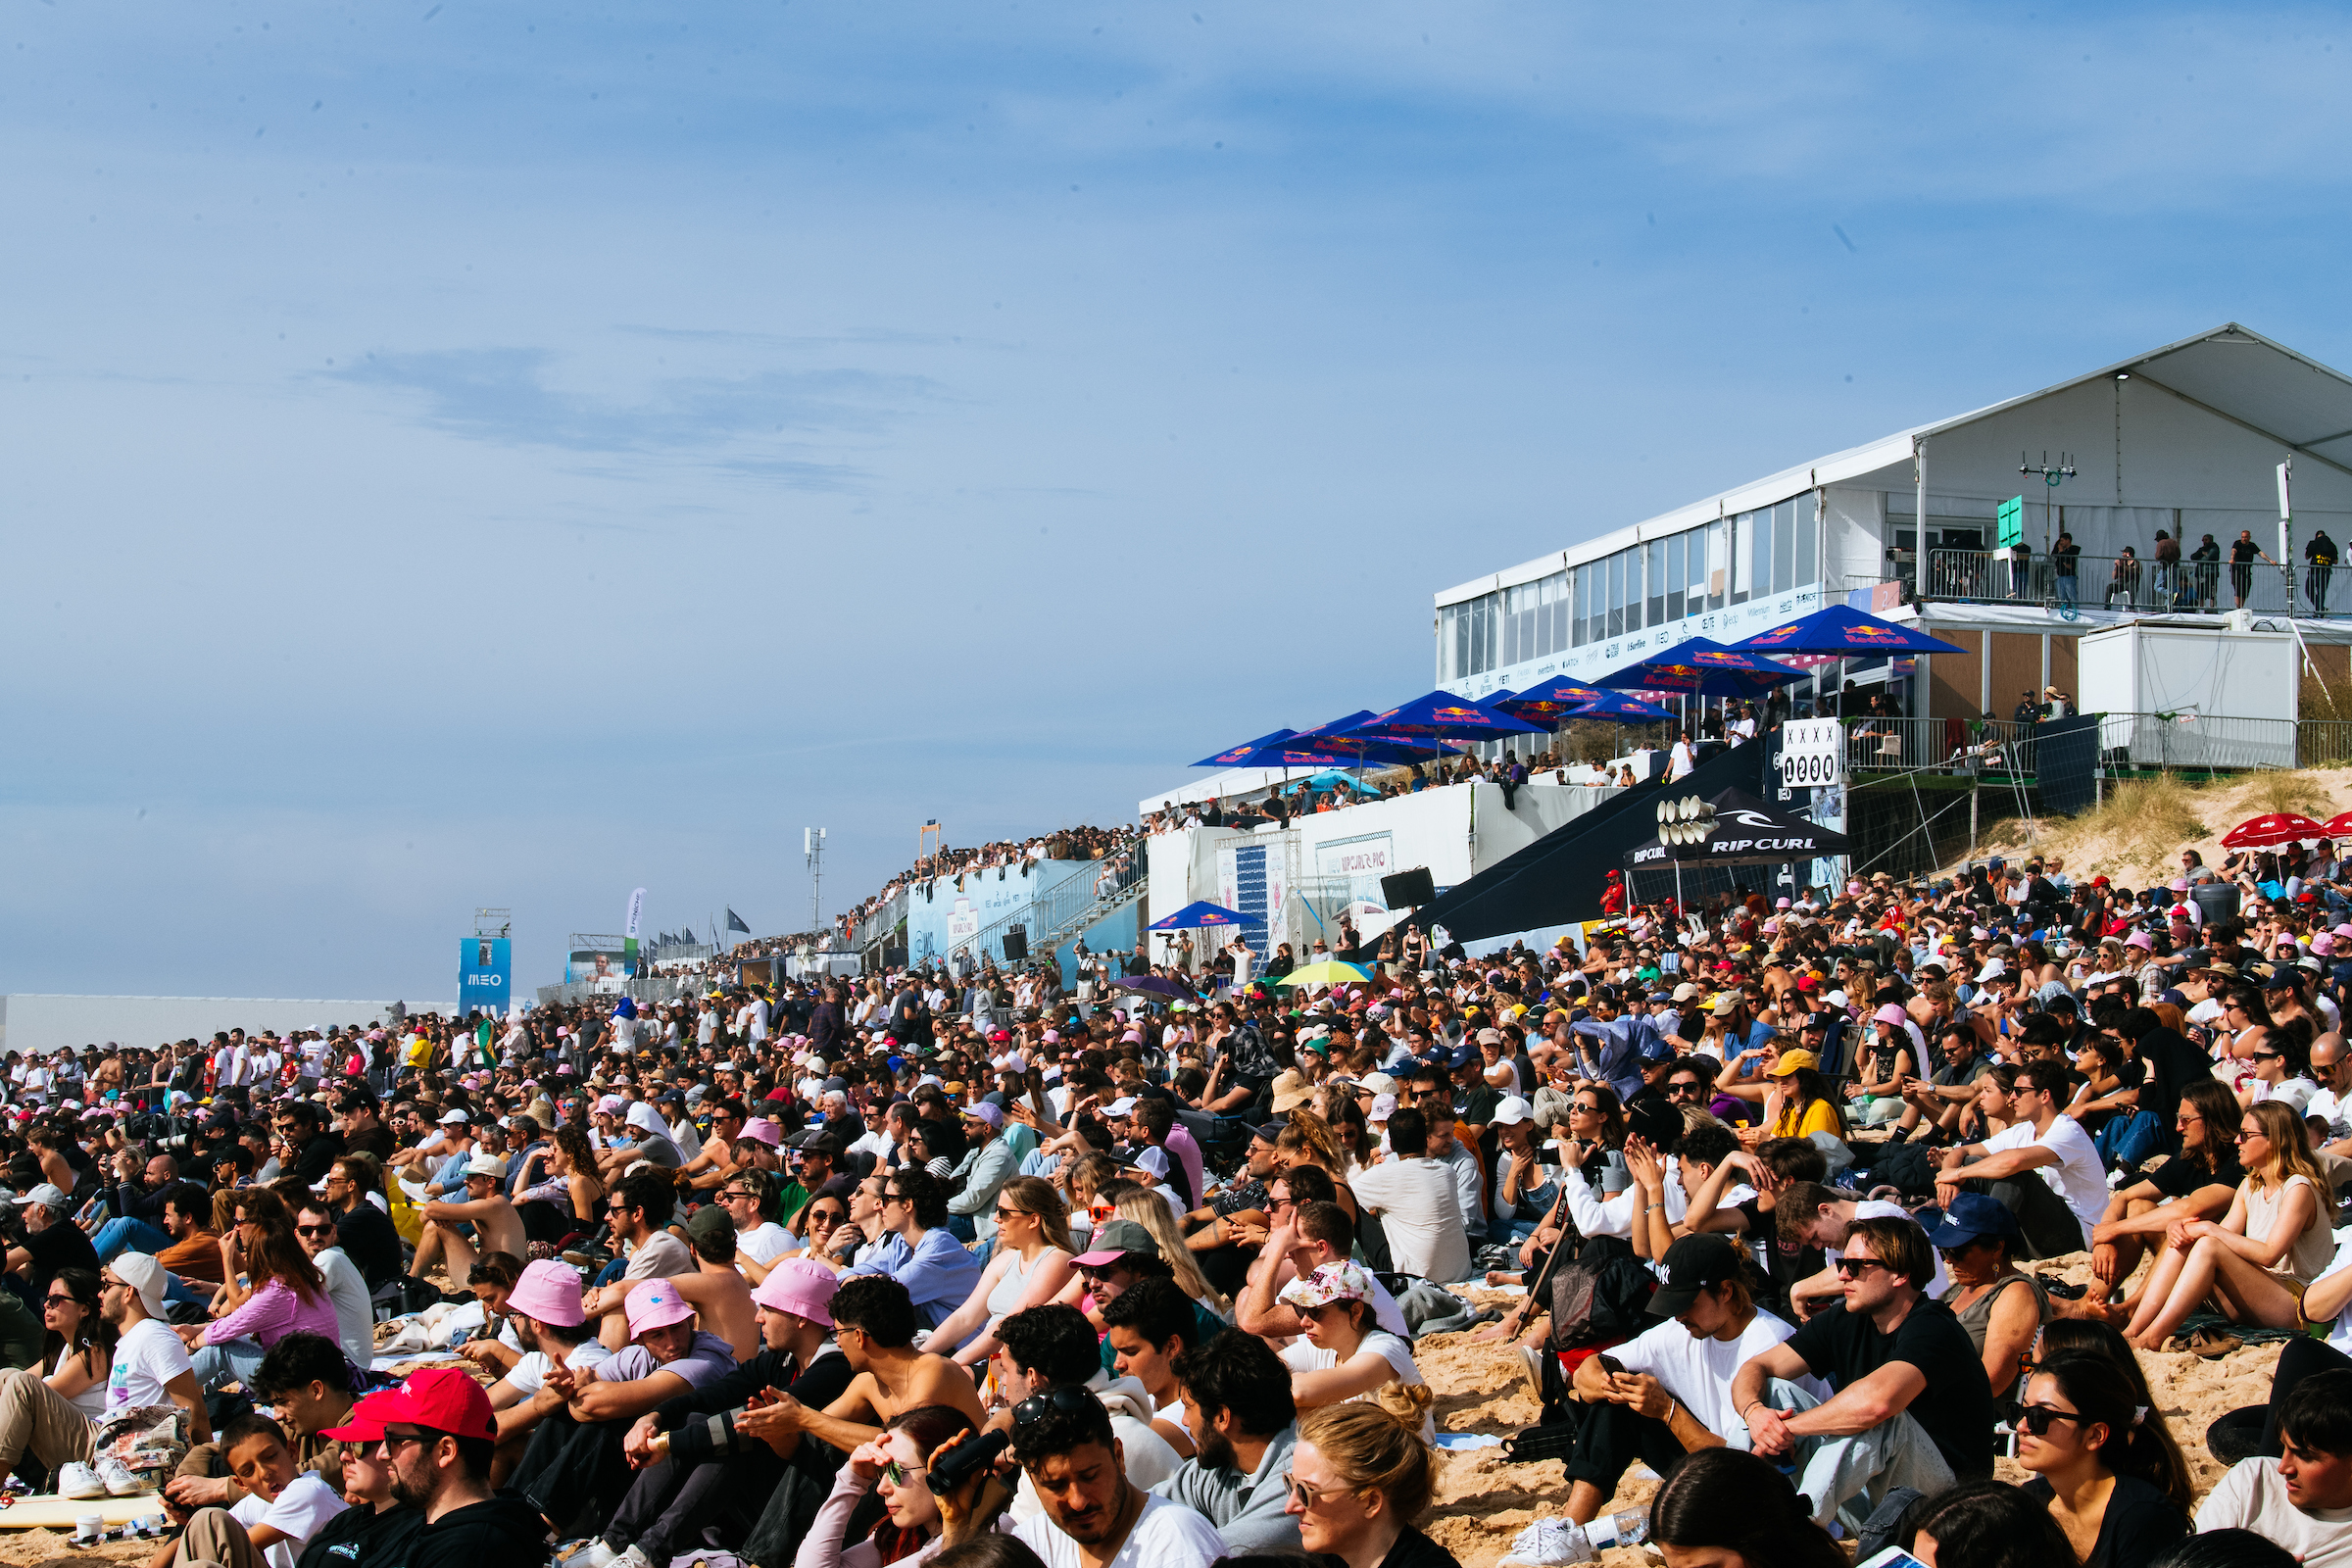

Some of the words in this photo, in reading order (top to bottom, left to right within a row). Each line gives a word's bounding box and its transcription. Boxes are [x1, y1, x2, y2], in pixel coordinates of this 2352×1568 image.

[1779, 599, 1792, 611] Hertz
[1882, 590, 1888, 608] 2
[1747, 605, 1771, 617] Millennium
[1728, 612, 1739, 626] edp
[1655, 631, 1669, 645] MEO
[1844, 635, 1875, 643] Red
[1876, 636, 1909, 644] Bull
[1693, 657, 1721, 665] Red
[1722, 659, 1754, 667] Bull
[1538, 664, 1555, 676] eventbrite
[1499, 674, 1510, 685] YETI
[1433, 714, 1462, 723] Red
[1462, 715, 1491, 724] Bull
[1787, 729, 1793, 744] X
[1800, 728, 1806, 743] X
[1813, 727, 1819, 743] X
[1827, 726, 1833, 742] X
[1786, 761, 1792, 779] 1
[1799, 760, 1805, 778] 2
[1812, 760, 1818, 778] 3
[1825, 759, 1831, 777] 4
[1712, 839, 1753, 853] RIP
[1754, 838, 1816, 850] CURL
[1634, 848, 1647, 863] RIP
[1647, 847, 1666, 862] CURL
[468, 974, 501, 986] MEO
